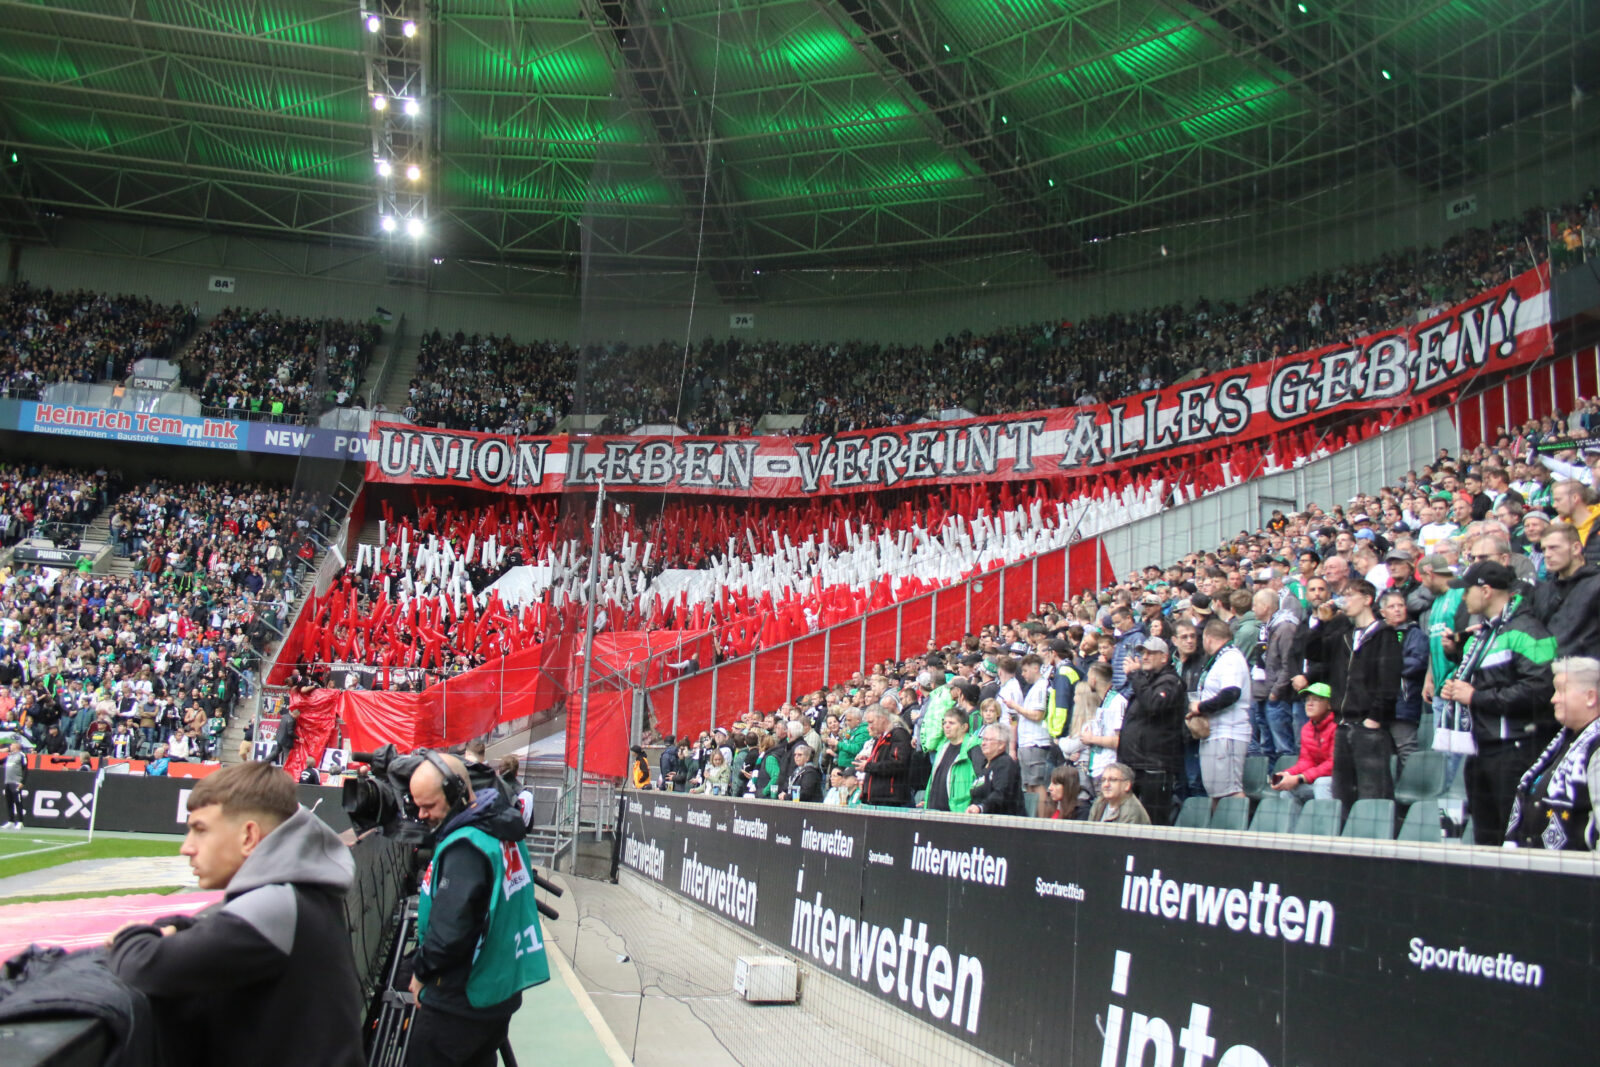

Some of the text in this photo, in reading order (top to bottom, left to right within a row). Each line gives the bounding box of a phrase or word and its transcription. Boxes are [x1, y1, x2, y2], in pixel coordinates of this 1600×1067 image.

[214, 280, 229, 288] 8A
[378, 428, 551, 487] UNION
[564, 440, 760, 489] LEBEN
[795, 417, 1046, 492] VEREINT
[1058, 374, 1252, 469] ALLES
[1268, 288, 1521, 422] GEBEN!
[34, 424, 159, 443] Bauunternehmen Baustoffe
[35, 404, 239, 440] Heinrich Temmink
[264, 429, 311, 449] NEW
[187, 439, 208, 447] GmbH
[733, 809, 768, 840] interwetten
[801, 818, 854, 859] interwetten
[868, 849, 894, 866] Sportwetten
[911, 832, 1008, 888] interwetten
[1035, 877, 1085, 902] Sportwetten
[1120, 855, 1335, 947] interwetten
[1407, 937, 1543, 988] Sportwetten
[514, 925, 543, 959] 21
[624, 822, 1270, 1067] interwetten interwetten interwetten int
